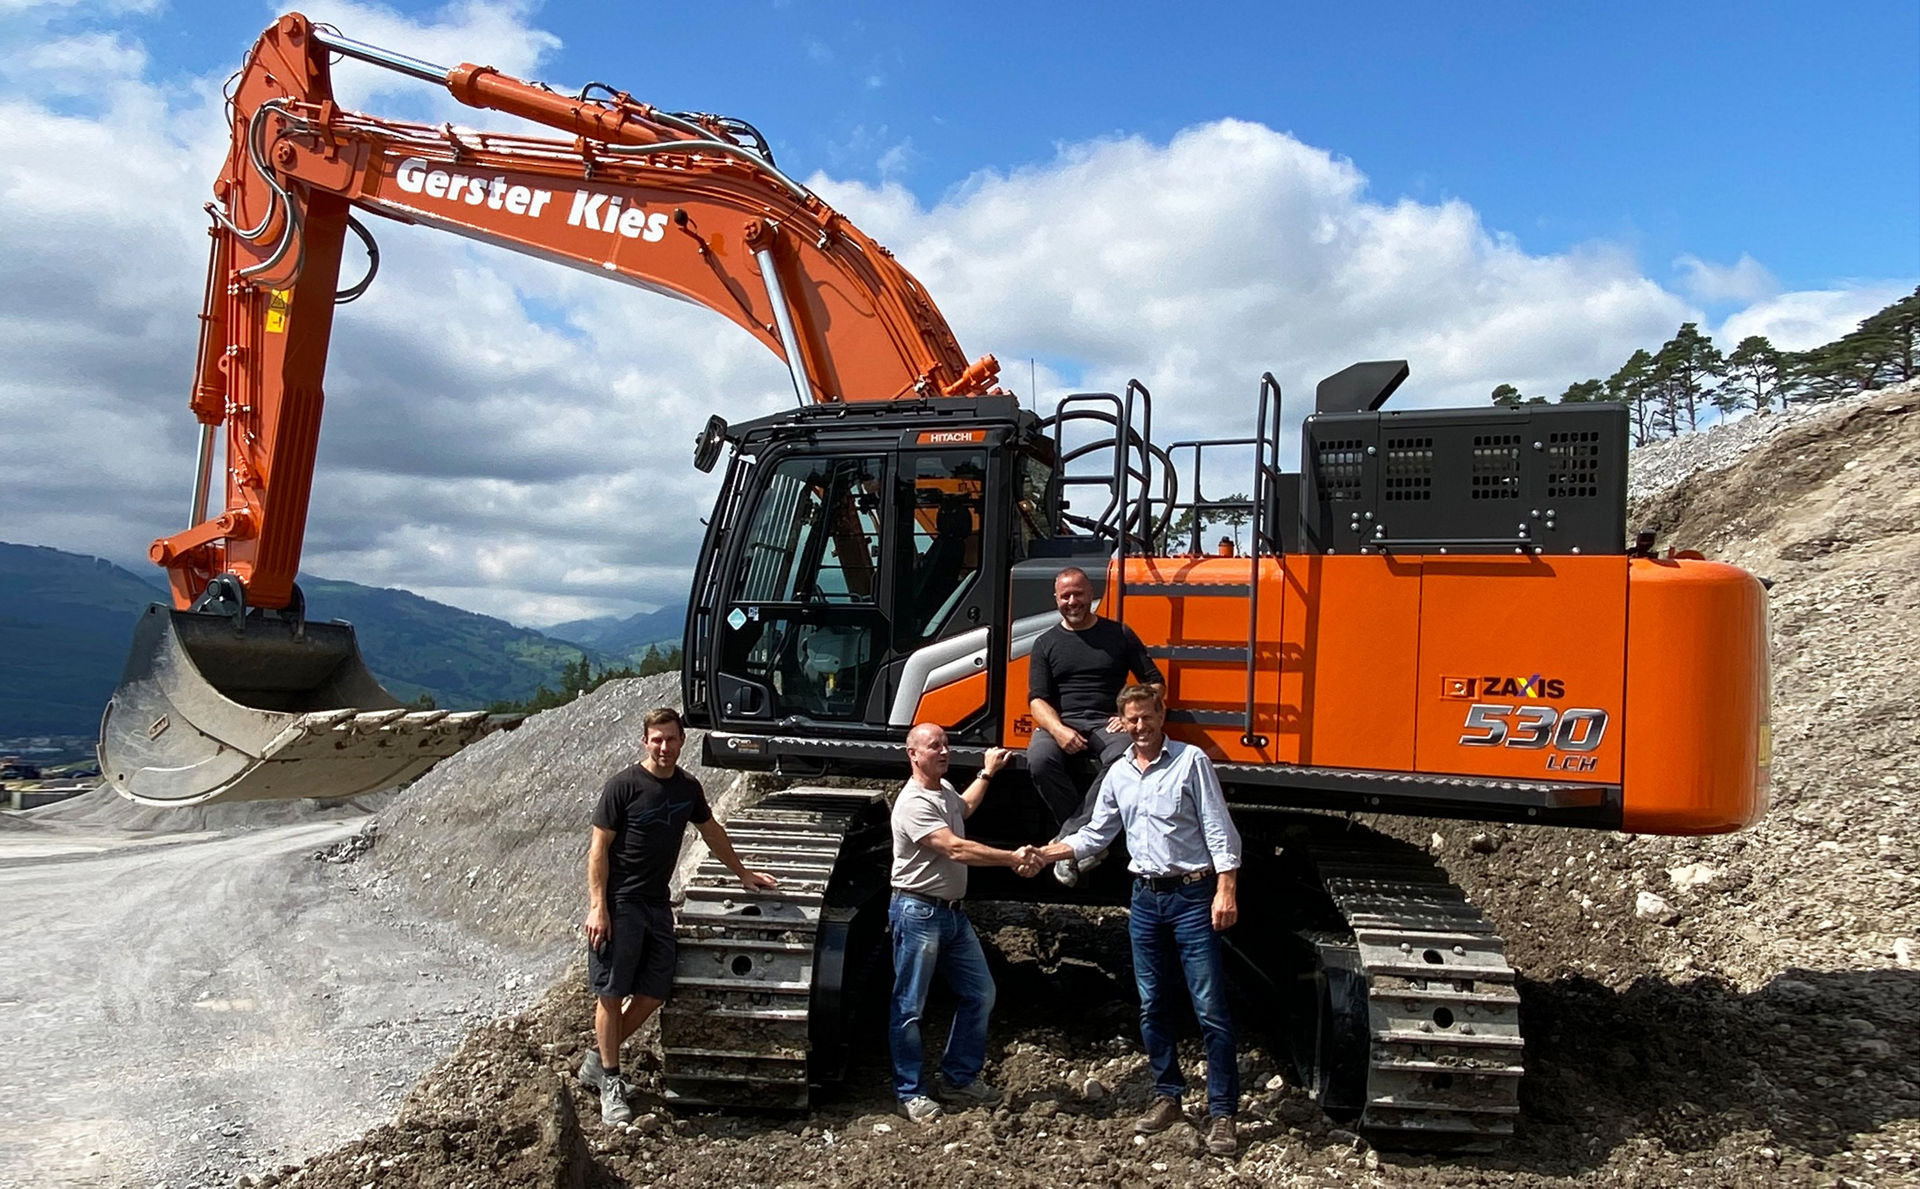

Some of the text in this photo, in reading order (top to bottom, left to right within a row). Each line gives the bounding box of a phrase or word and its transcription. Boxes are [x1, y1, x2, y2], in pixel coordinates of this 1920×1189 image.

[396, 157, 669, 242] Gerster Kies
[930, 432, 973, 443] HITACHI
[1483, 673, 1565, 698] ZAXIS
[1458, 703, 1610, 752] 530
[1545, 753, 1598, 773] LCH
